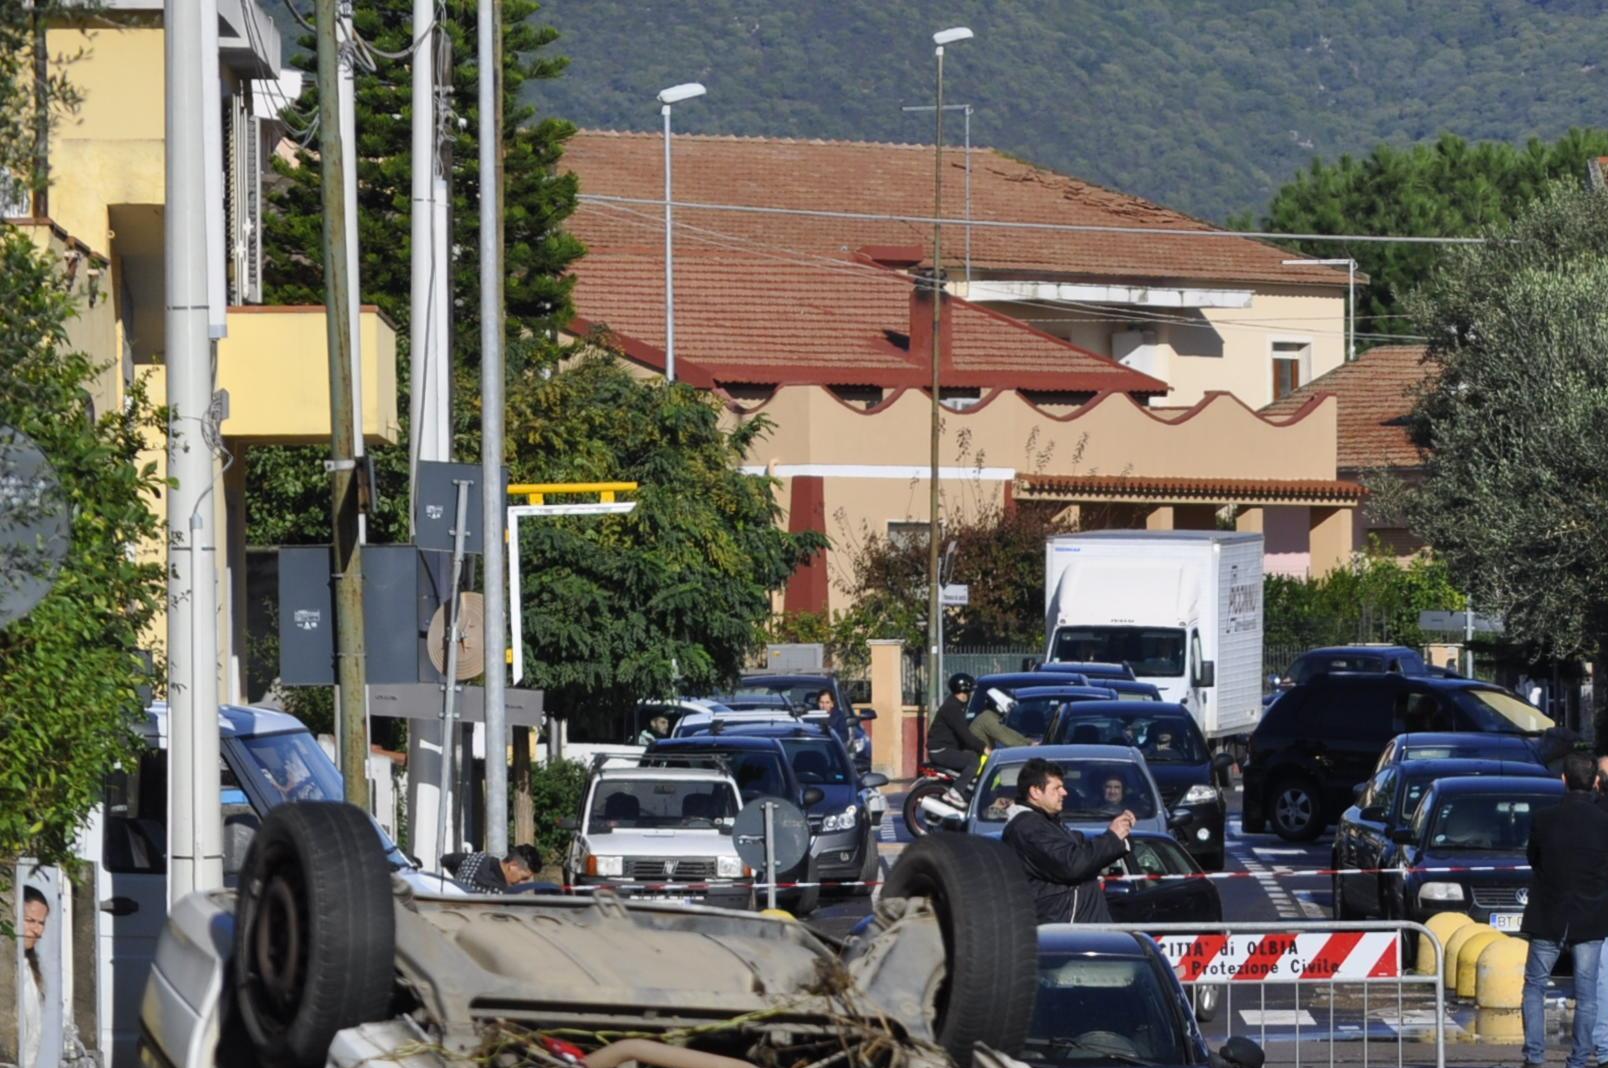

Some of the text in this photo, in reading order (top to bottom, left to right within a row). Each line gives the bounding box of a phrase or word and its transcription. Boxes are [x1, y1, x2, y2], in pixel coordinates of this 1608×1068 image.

[1220, 939, 1235, 957] di
[1247, 941, 1299, 956] OLBIA
[1191, 961, 1279, 976] Protezione
